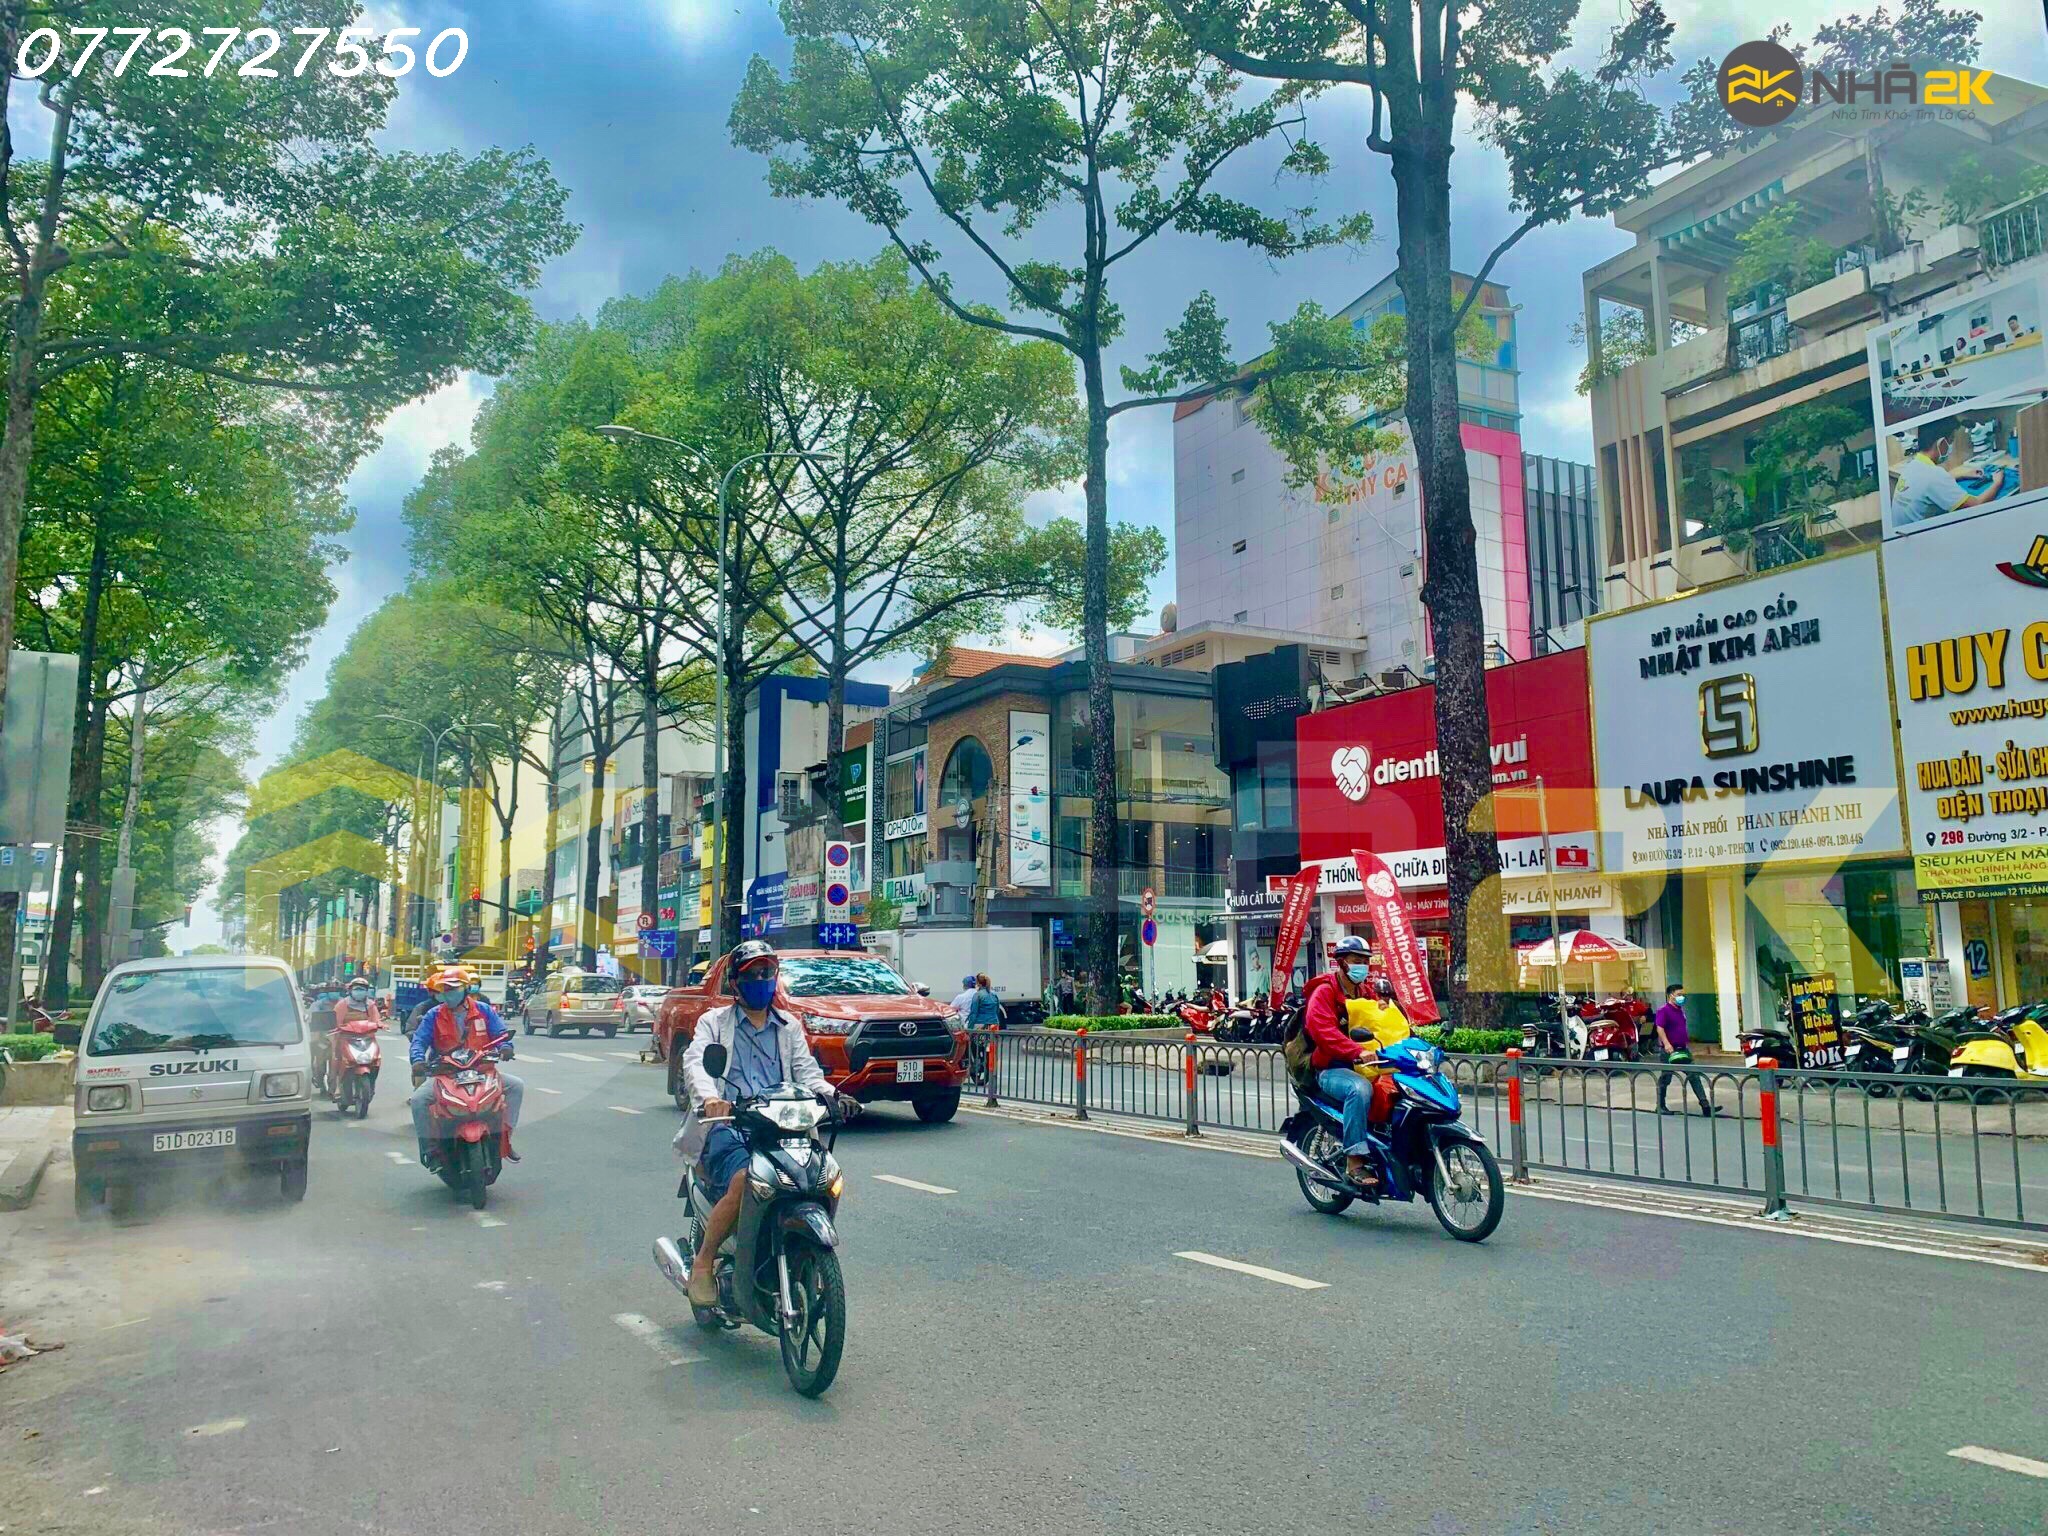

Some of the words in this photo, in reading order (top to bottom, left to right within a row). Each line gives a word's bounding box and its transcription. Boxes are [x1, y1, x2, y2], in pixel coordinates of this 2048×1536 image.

[1724, 609, 1757, 630] CAO
[1639, 644, 1702, 679] NHẬT
[1708, 633, 1757, 665] KIM
[1762, 618, 1821, 652] ANH
[1906, 628, 2010, 700] HUY
[1917, 759, 1950, 790] MUA
[1950, 750, 1983, 787] BÁN
[1996, 740, 2030, 782] SỬA
[1624, 775, 1708, 810] LAURA
[1714, 755, 1857, 798] SUNSHINE
[1936, 789, 1984, 823] ĐIỆN
[1647, 825, 1670, 840] NHÀ
[1672, 820, 1700, 839] PHÂN
[1702, 814, 1729, 835] PHỐI
[1736, 811, 1776, 832] PHAN
[1779, 804, 1831, 826] KHÁNH
[1834, 802, 1863, 820] NHI
[1941, 830, 1964, 845] 298
[1967, 828, 2007, 843] Đường
[2010, 828, 2027, 840] 3/2
[1673, 848, 1683, 859] 3/2
[1919, 855, 1951, 868] SIÊU
[1394, 857, 1429, 878] CHỮA
[1953, 868, 1971, 876] PIN
[1974, 863, 2010, 874] CHÍNH
[1979, 875, 1990, 883] 18
[1992, 871, 2033, 881] THÁNG
[1553, 885, 1602, 902] NHANH
[1941, 889, 1964, 900] FACE
[1966, 889, 1976, 898] ID
[2008, 887, 2017, 896] 12
[1386, 900, 1430, 1003] dienthoaivui
[1967, 942, 1988, 970] 12
[149, 1058, 239, 1077] SUZUKI
[1803, 1046, 1843, 1068] 30K
